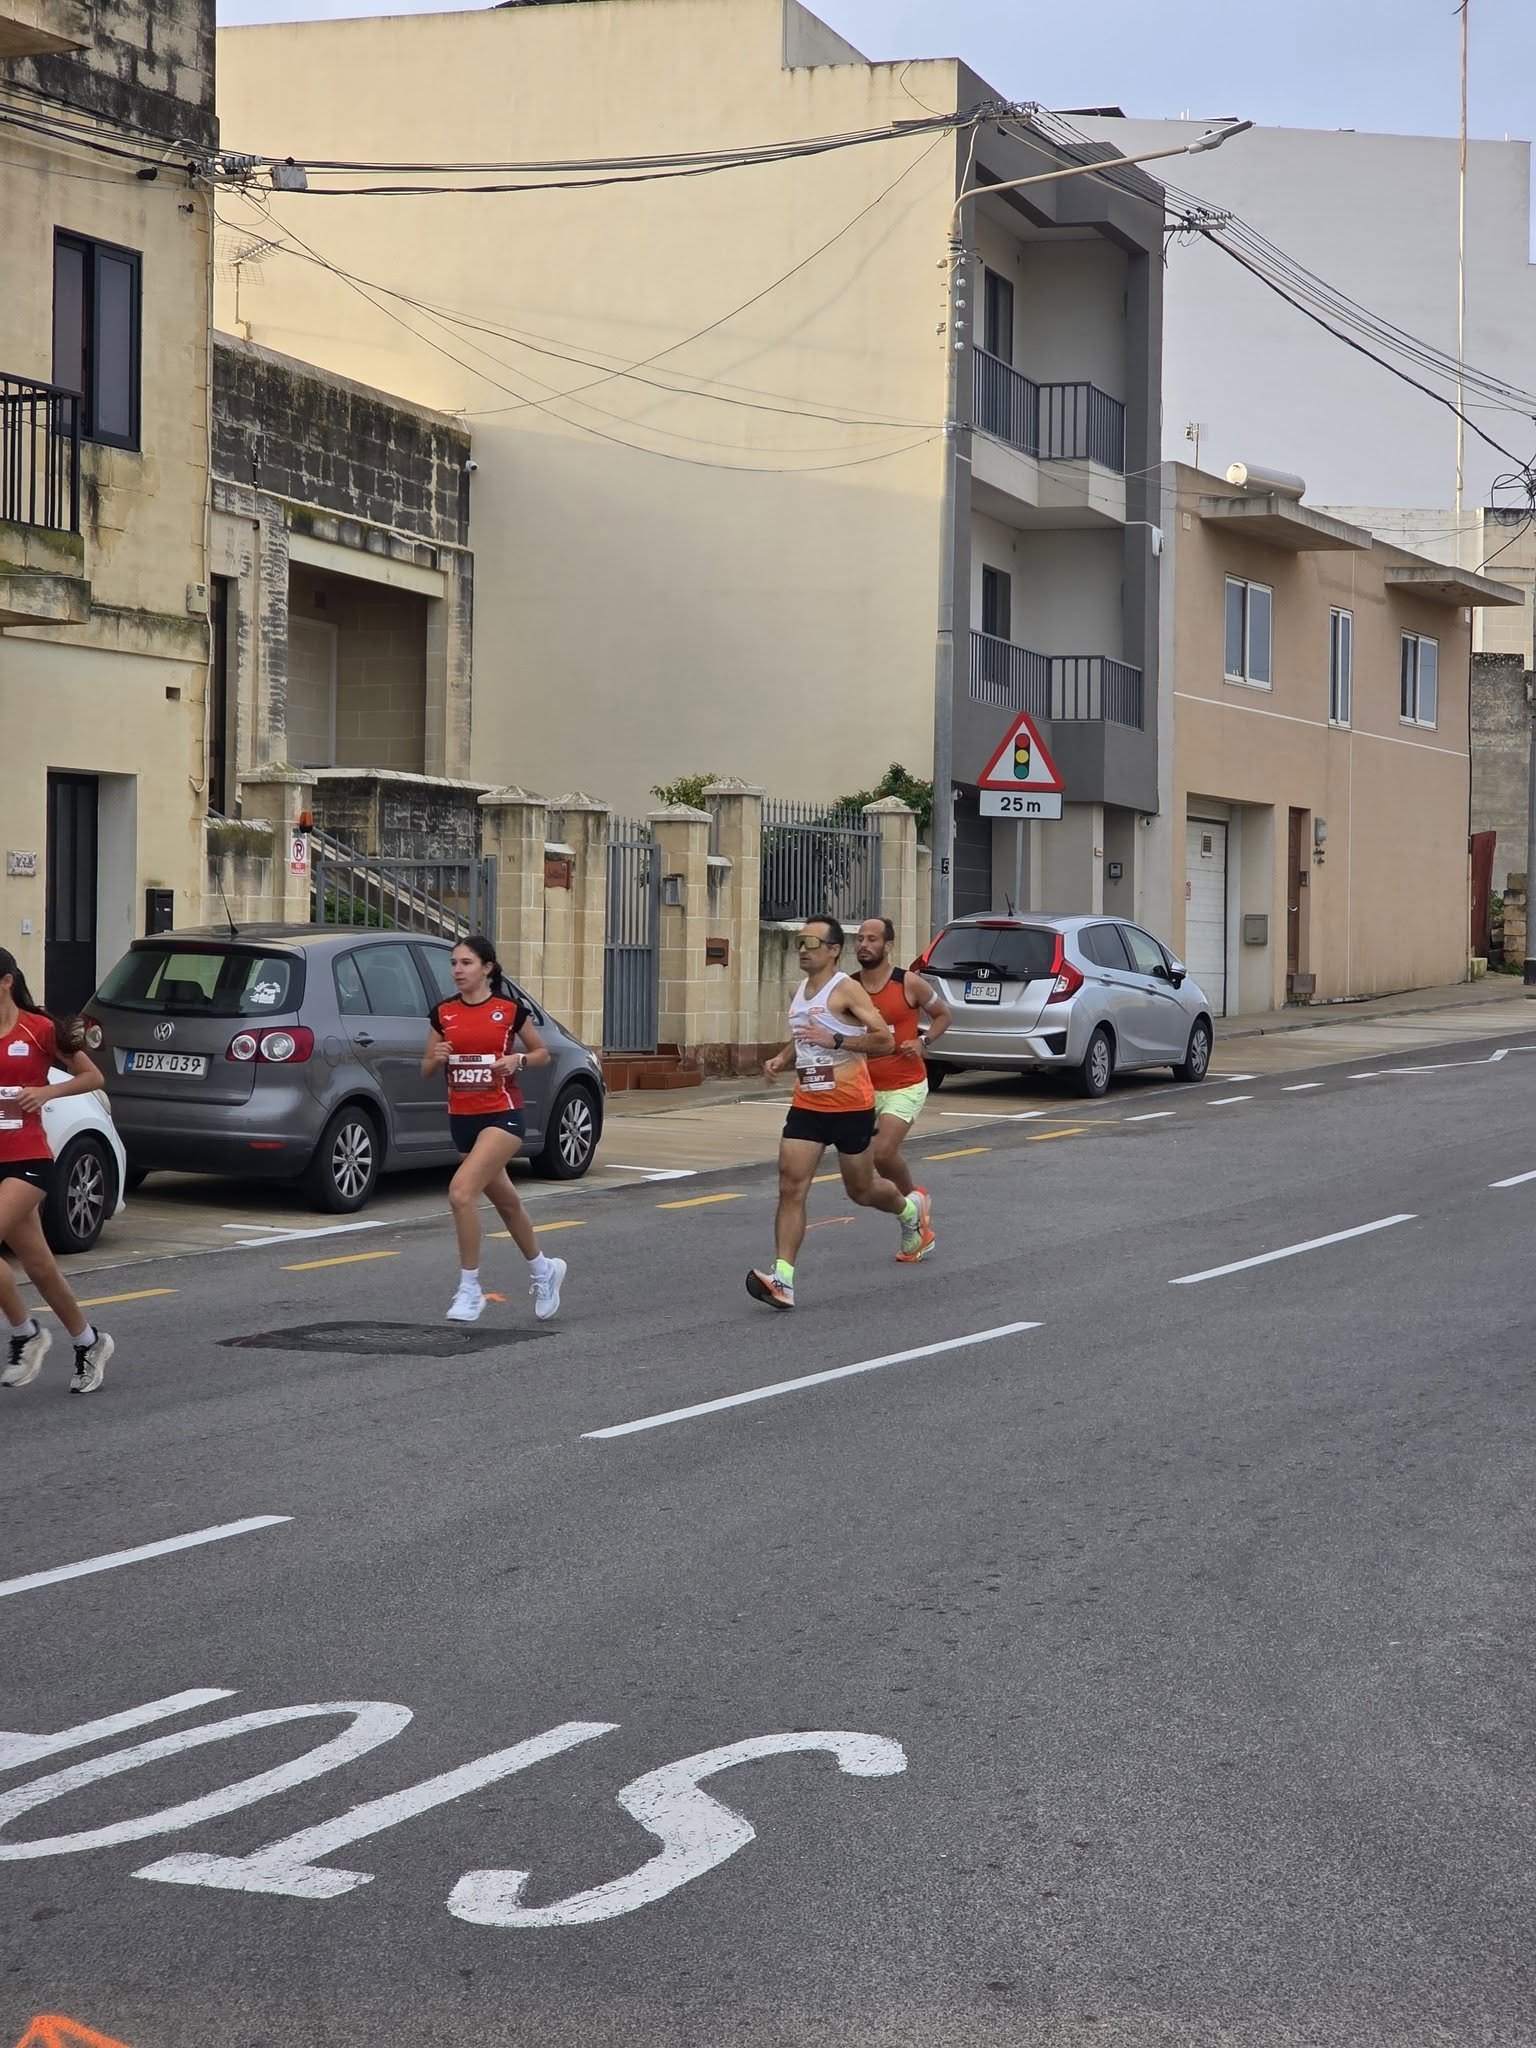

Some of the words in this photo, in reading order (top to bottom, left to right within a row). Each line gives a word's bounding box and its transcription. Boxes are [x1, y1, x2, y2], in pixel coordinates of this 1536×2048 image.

[1000, 796, 1023, 812] 25
[1026, 801, 1041, 813] m
[972, 986, 984, 997] CEF
[985, 986, 998, 997] 421
[135, 1053, 165, 1071] DBX
[169, 1056, 202, 1073] 039
[452, 1068, 493, 1083] 12973
[0, 1687, 909, 1929] STO
